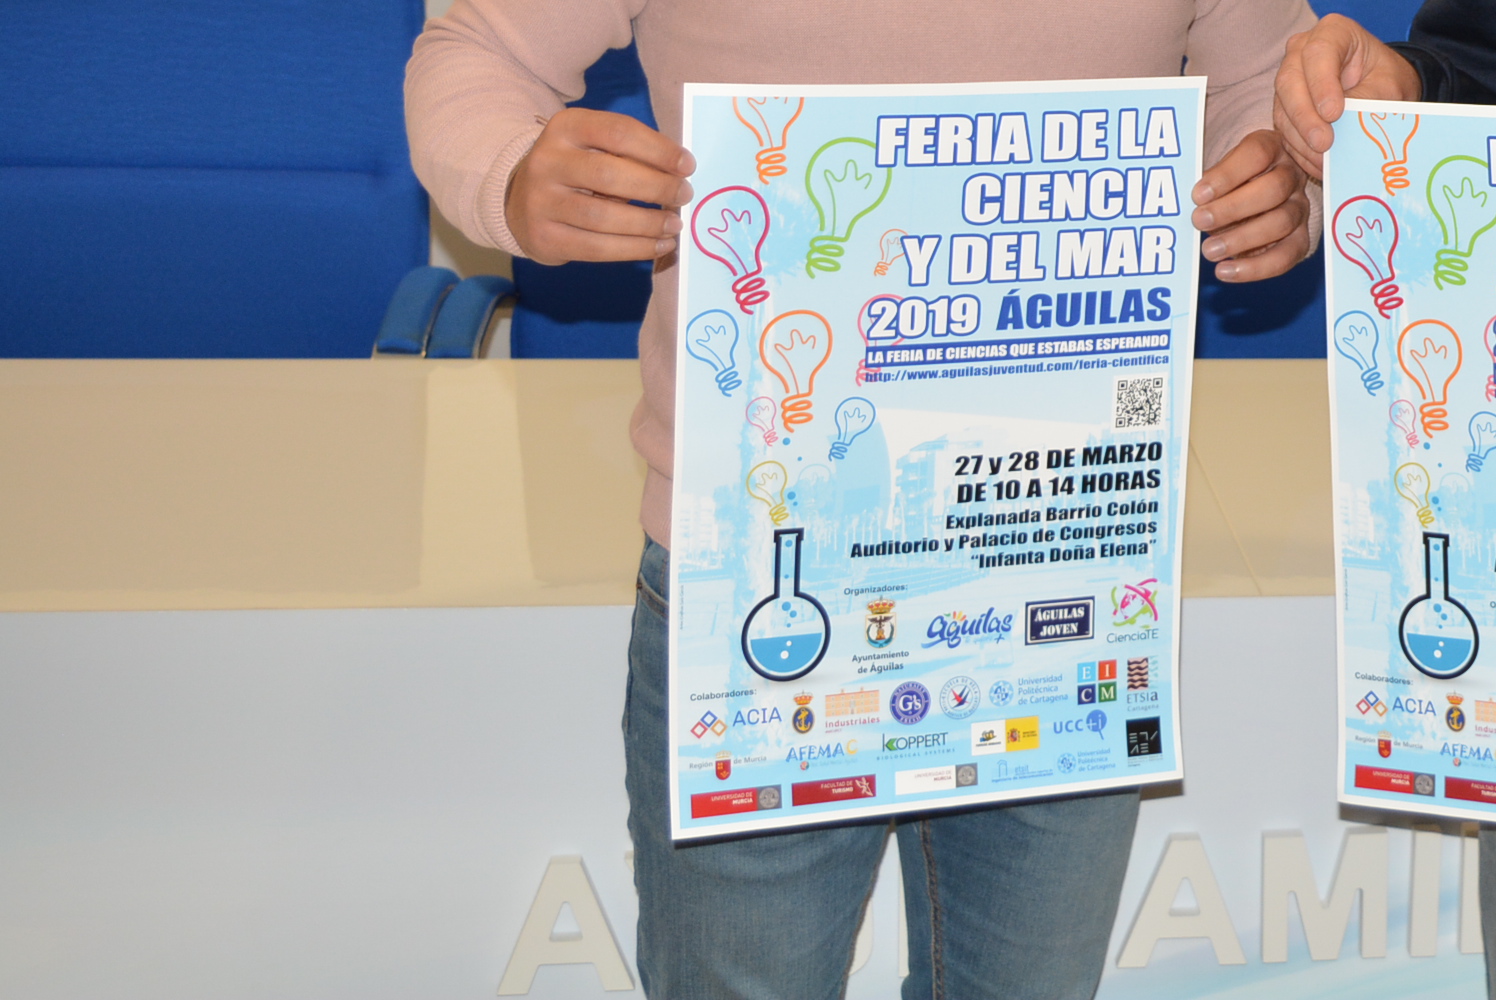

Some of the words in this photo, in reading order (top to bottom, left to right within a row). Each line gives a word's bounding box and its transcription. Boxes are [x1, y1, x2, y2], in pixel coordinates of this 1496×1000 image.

[875, 112, 1032, 167] FERIA
[1041, 109, 1109, 163] DE
[1118, 107, 1181, 160] LA
[962, 166, 1180, 225] CIENCIA
[901, 234, 942, 286] Y
[949, 231, 1045, 285] DEL
[1055, 225, 1176, 280] MAR
[867, 294, 980, 340] 2019
[996, 287, 1172, 331] ÁGUILAS
[868, 352, 884, 364] LA
[886, 349, 924, 363] FERIA
[926, 348, 943, 361] DE
[946, 344, 1007, 359] CIENCIAS
[1011, 343, 1035, 357] QUE
[1038, 339, 1093, 354] ESTABAS
[1096, 334, 1168, 350] ESPERANDO
[955, 455, 983, 476] 27
[989, 456, 1003, 475] y
[1008, 451, 1039, 472] 28
[1047, 448, 1075, 469] DE
[1081, 442, 1162, 467] MARZO
[957, 483, 987, 504] DE
[993, 480, 1020, 500] 10
[1026, 478, 1042, 498] A
[1049, 476, 1075, 496] 14
[1081, 469, 1161, 494] HORAS
[946, 509, 1041, 530] Explanada
[1046, 504, 1102, 521] Barrio
[1107, 499, 1158, 516] Colón
[851, 538, 939, 558] Auditorio
[944, 538, 954, 552] y
[959, 530, 1028, 549] Palacio
[1033, 528, 1055, 543] de
[1060, 521, 1157, 540] Congresos
[971, 551, 1045, 568] “Infanta
[1050, 544, 1095, 562] Doña
[1101, 539, 1156, 558] Elena”
[844, 583, 908, 596] Organizadores:
[1034, 607, 1084, 622] ÁGUILAS
[1040, 622, 1078, 636] JOVEN
[1106, 628, 1159, 644] CienciaTE
[852, 651, 909, 662] Ayuntamiento
[858, 666, 868, 674] de
[870, 662, 904, 674] Águilas
[1018, 674, 1062, 686] Universidad
[1355, 672, 1413, 685] Colaboradores:
[690, 689, 757, 701] Colaboradores:
[1018, 685, 1058, 695] Politécnica
[899, 695, 921, 711] G's
[1030, 694, 1068, 704] Cartagena
[1392, 697, 1437, 716] ACIA
[732, 707, 782, 727] ACIA
[785, 739, 858, 762] AFEMAC
[689, 760, 713, 770] Región
[744, 755, 766, 763] Murcia
